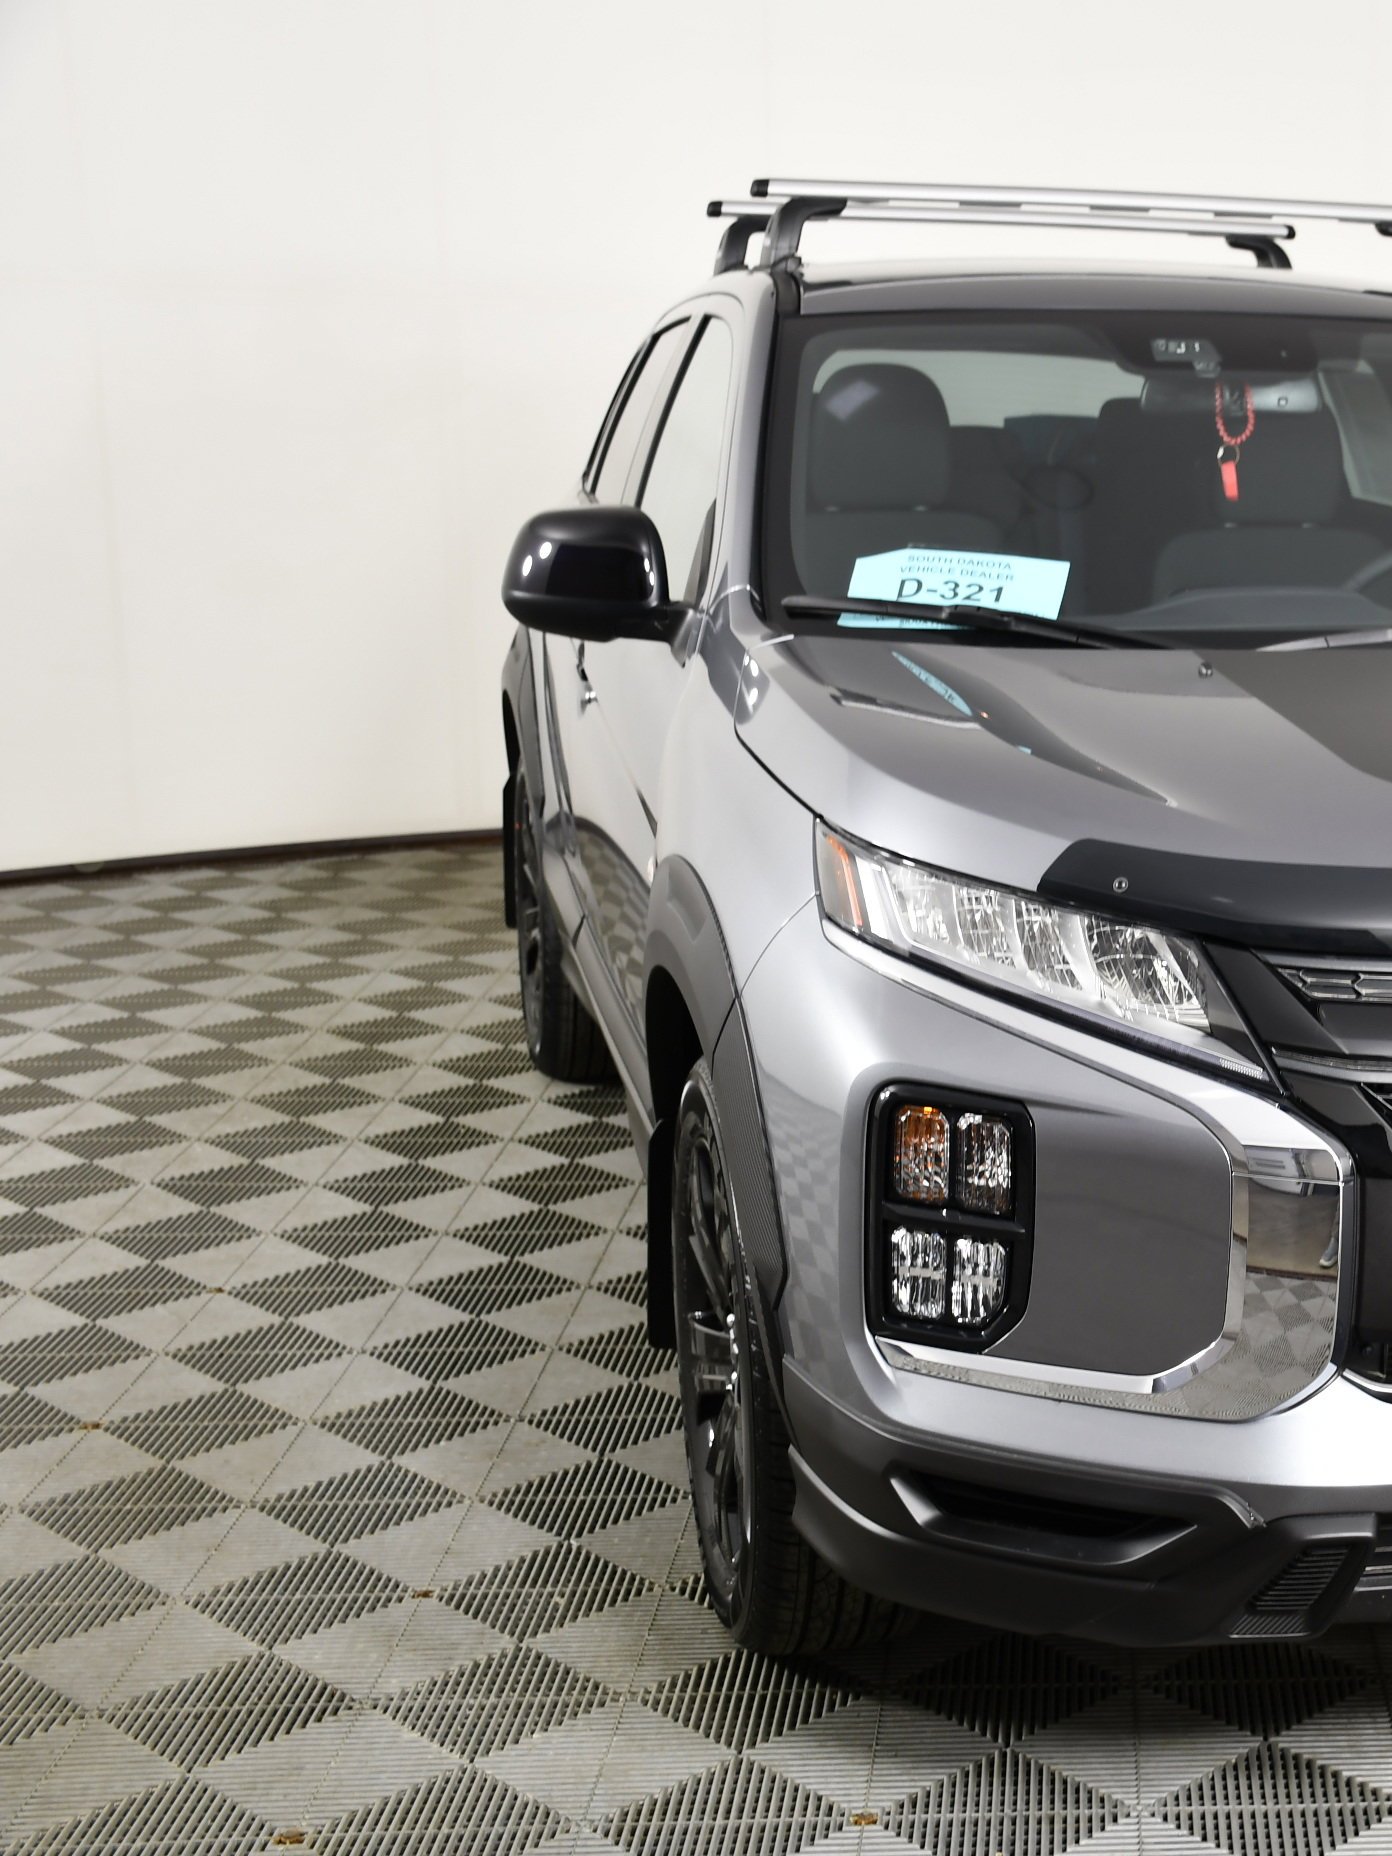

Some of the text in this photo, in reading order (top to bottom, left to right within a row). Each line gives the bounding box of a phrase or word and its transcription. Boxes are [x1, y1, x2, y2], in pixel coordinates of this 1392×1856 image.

[907, 554, 1012, 570] SOUTH DAKOTA
[900, 564, 1014, 582] VEHICLE DEALER
[896, 577, 1004, 603] D-321
